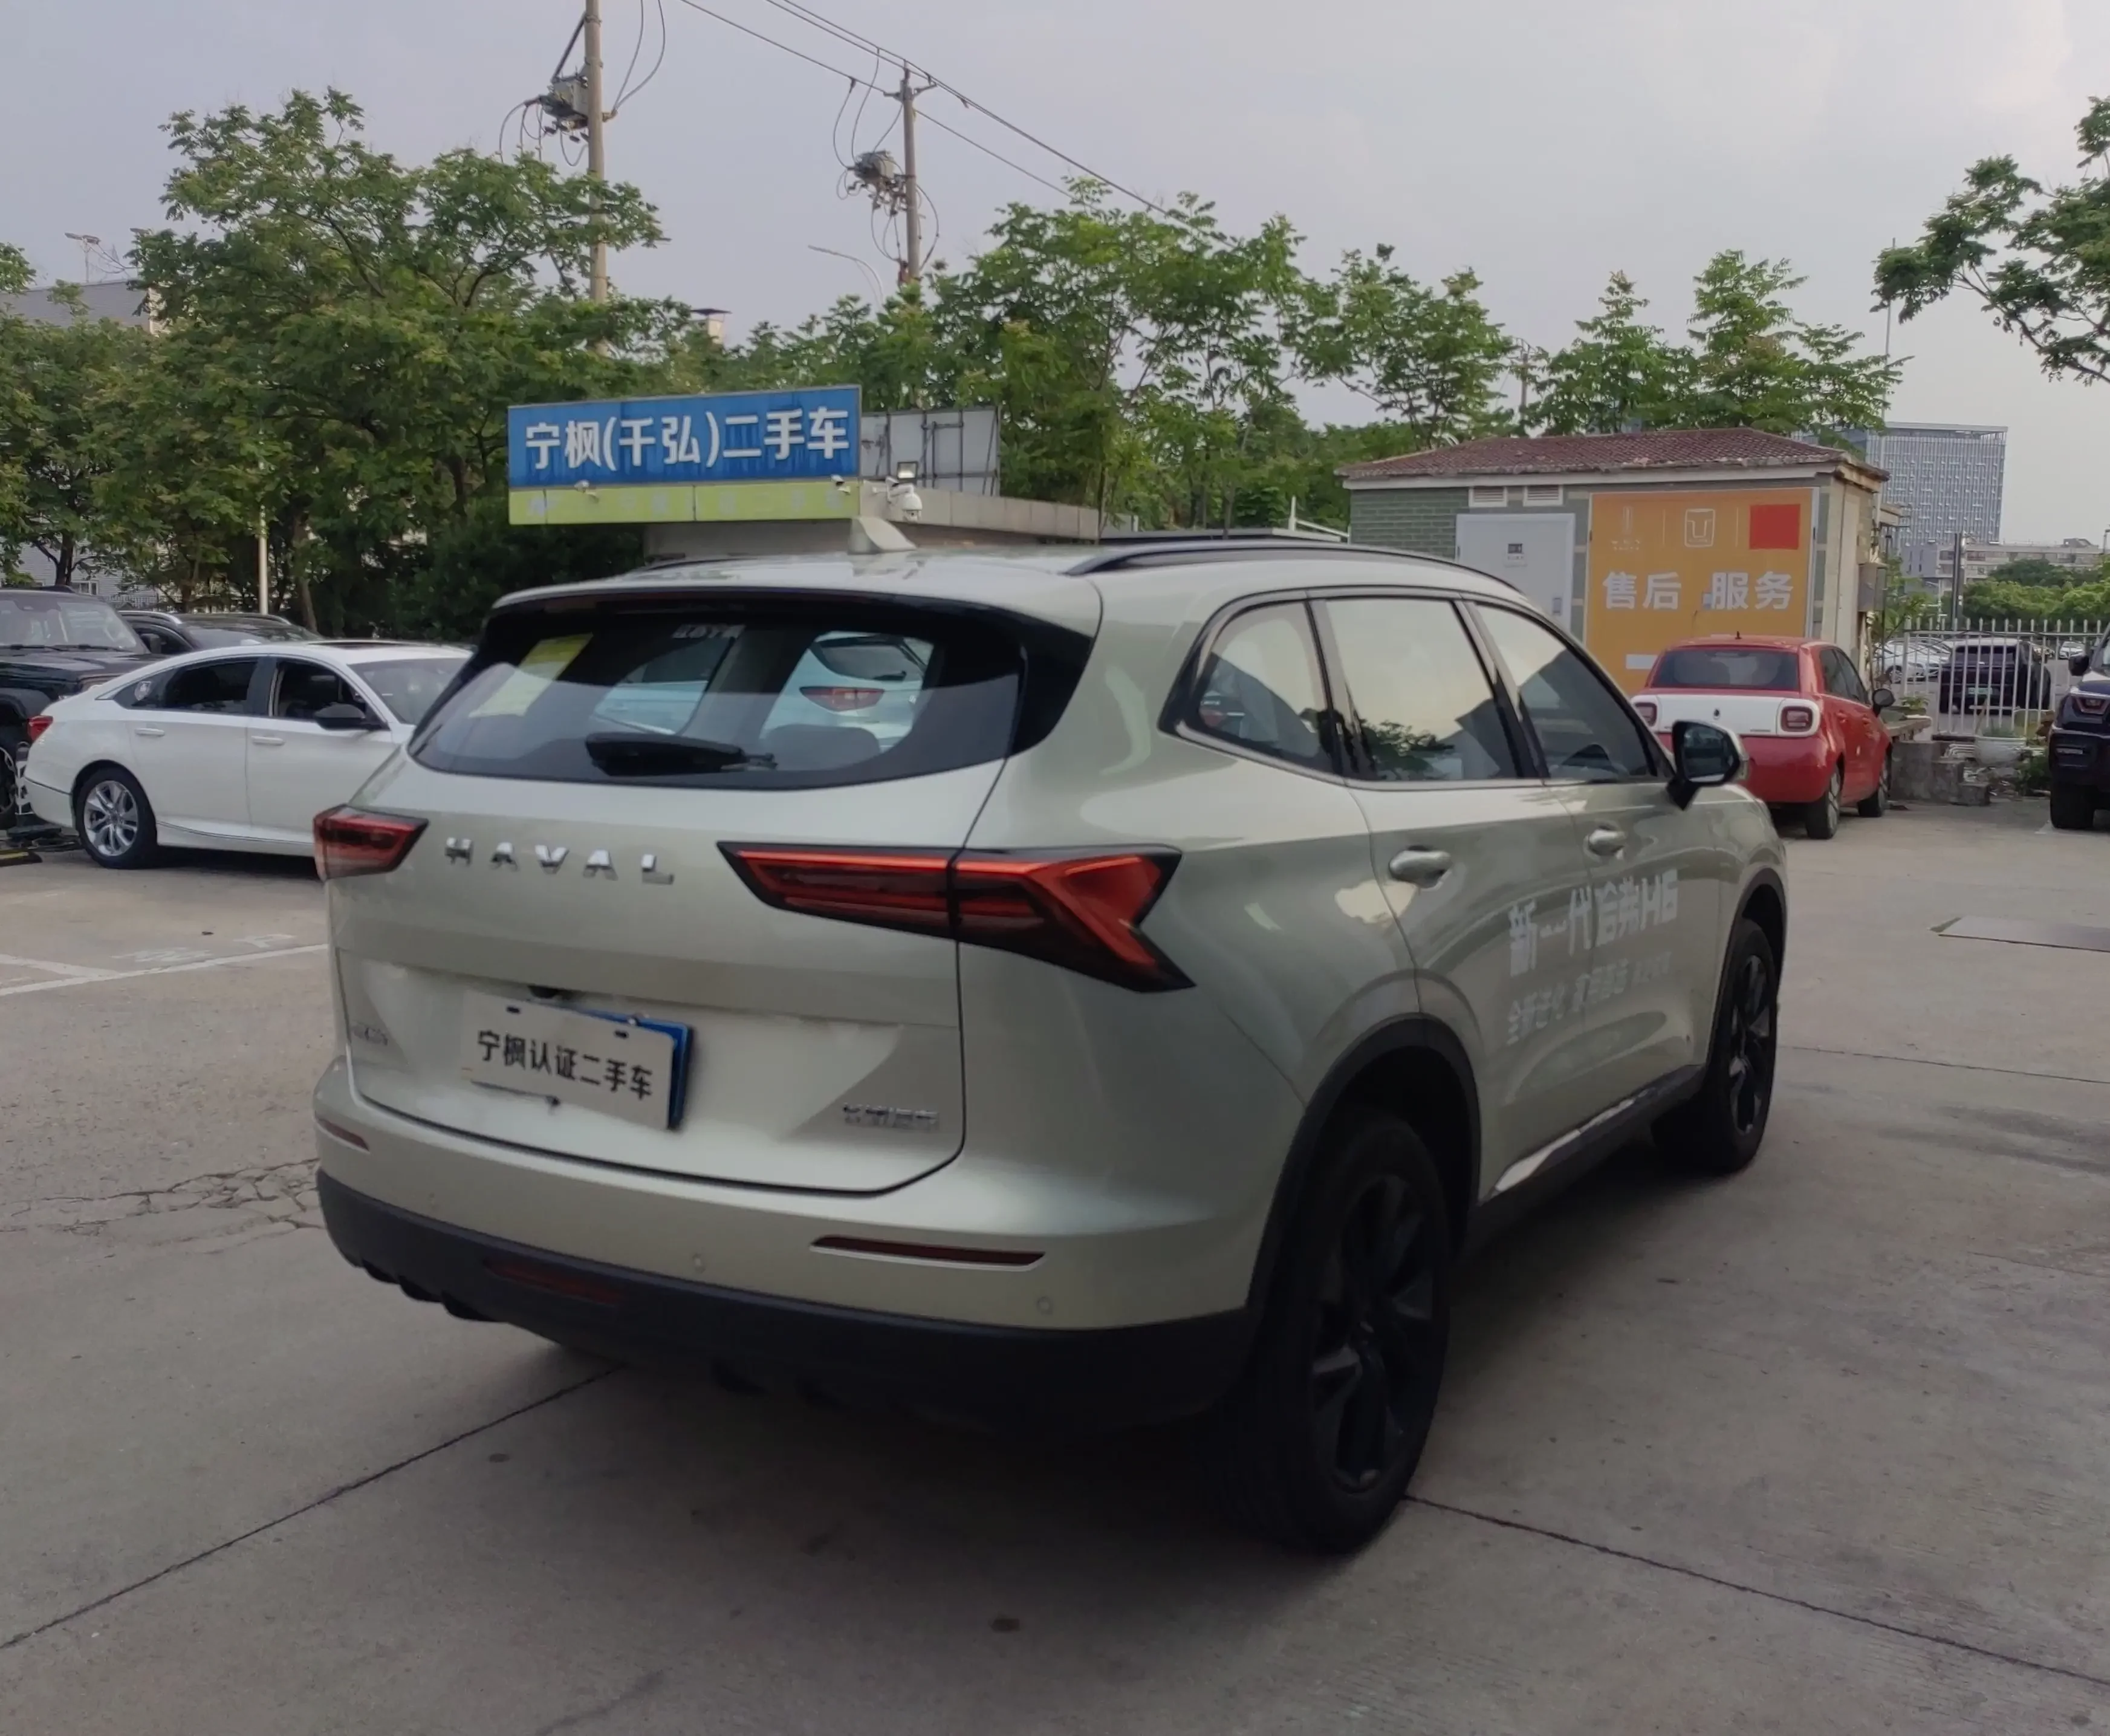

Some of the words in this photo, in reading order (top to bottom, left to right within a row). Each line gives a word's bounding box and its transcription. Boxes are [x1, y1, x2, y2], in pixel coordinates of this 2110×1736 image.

[525, 405, 850, 471] 宁枫(千弘)二手车
[1602, 570, 1682, 610] 售后
[1710, 570, 1794, 610] 服务
[444, 837, 675, 885] HAVAL
[477, 1030, 653, 1100] 宁枫认证二手车
